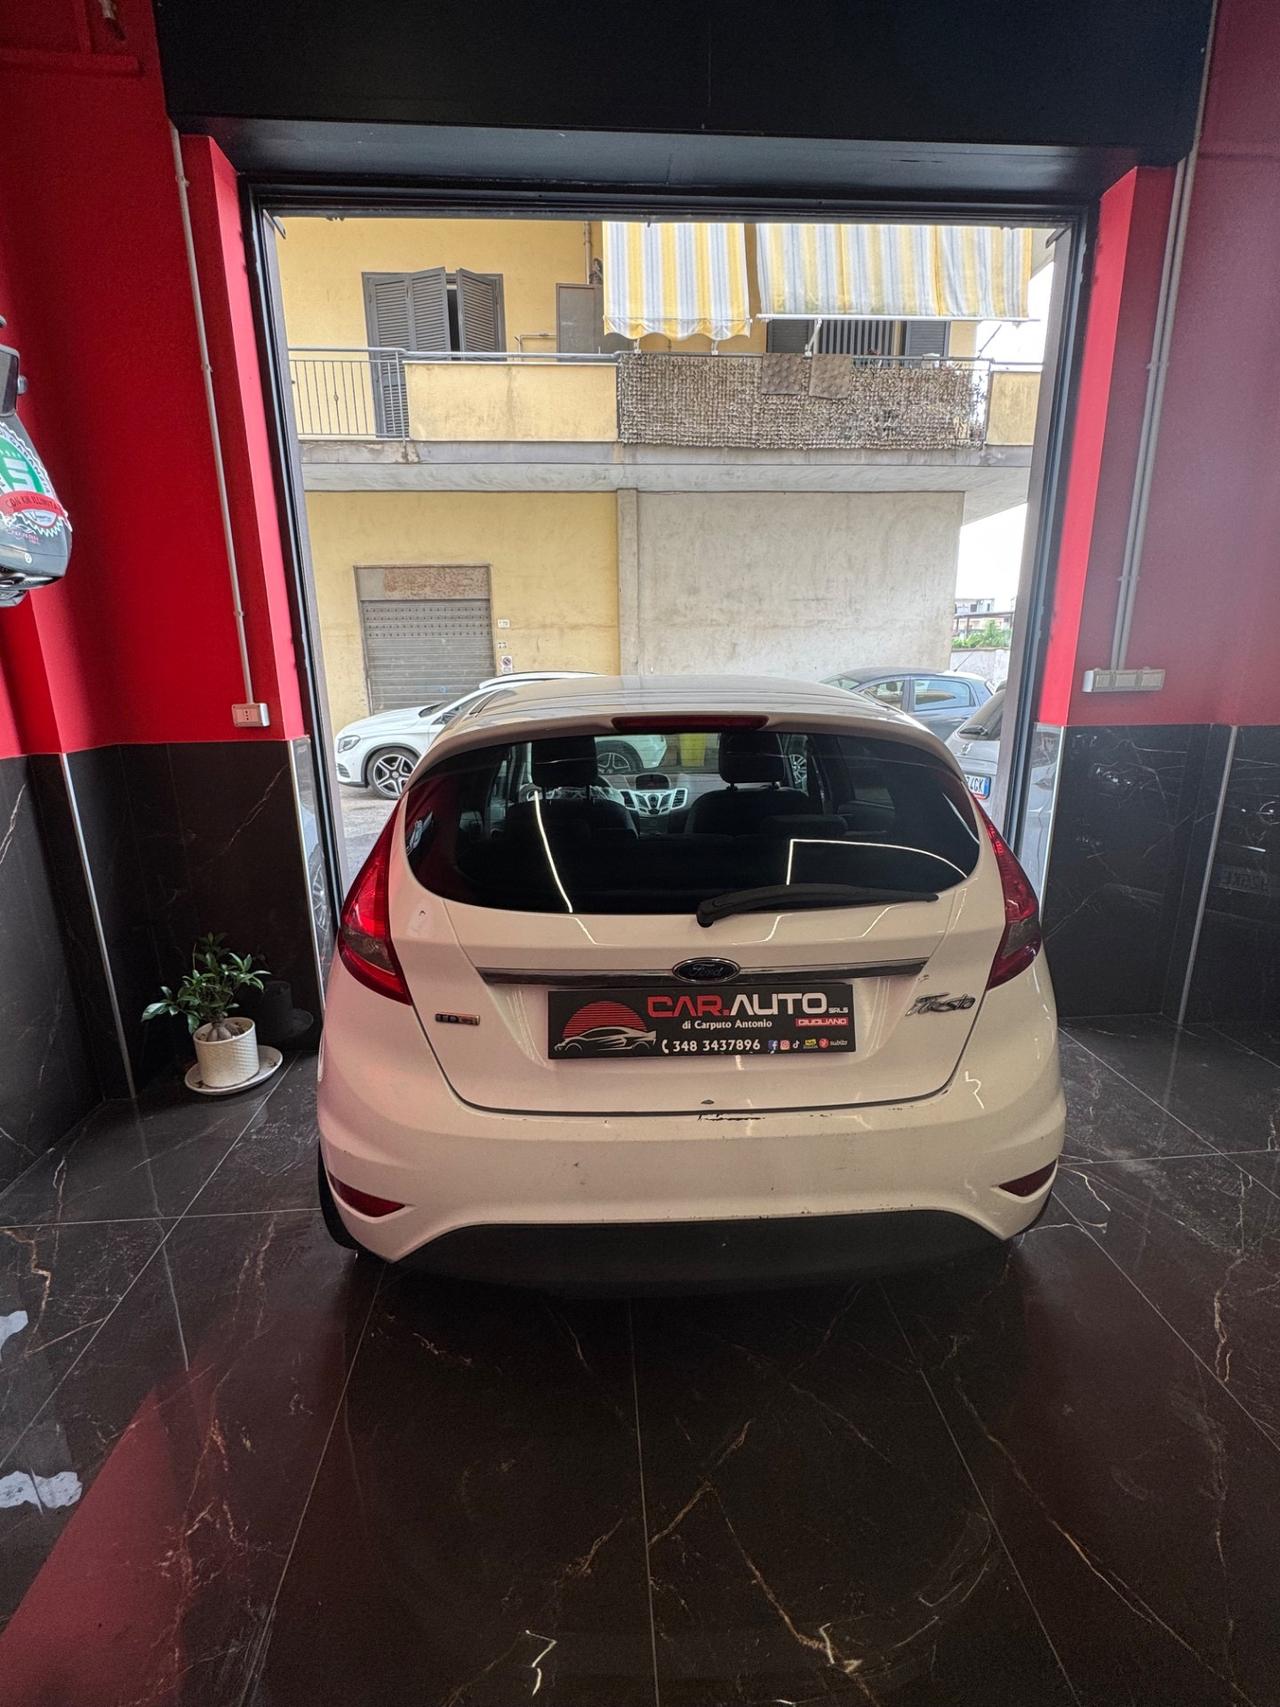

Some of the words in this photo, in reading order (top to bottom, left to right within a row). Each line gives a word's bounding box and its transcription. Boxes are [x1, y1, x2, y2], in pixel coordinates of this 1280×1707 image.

[687, 963, 724, 978] Ford
[681, 1020, 692, 1030] di
[694, 1020, 732, 1031] Carputo
[734, 1019, 773, 1029] Antonio
[672, 1040, 698, 1053] 348
[702, 1039, 761, 1051] 3437896
